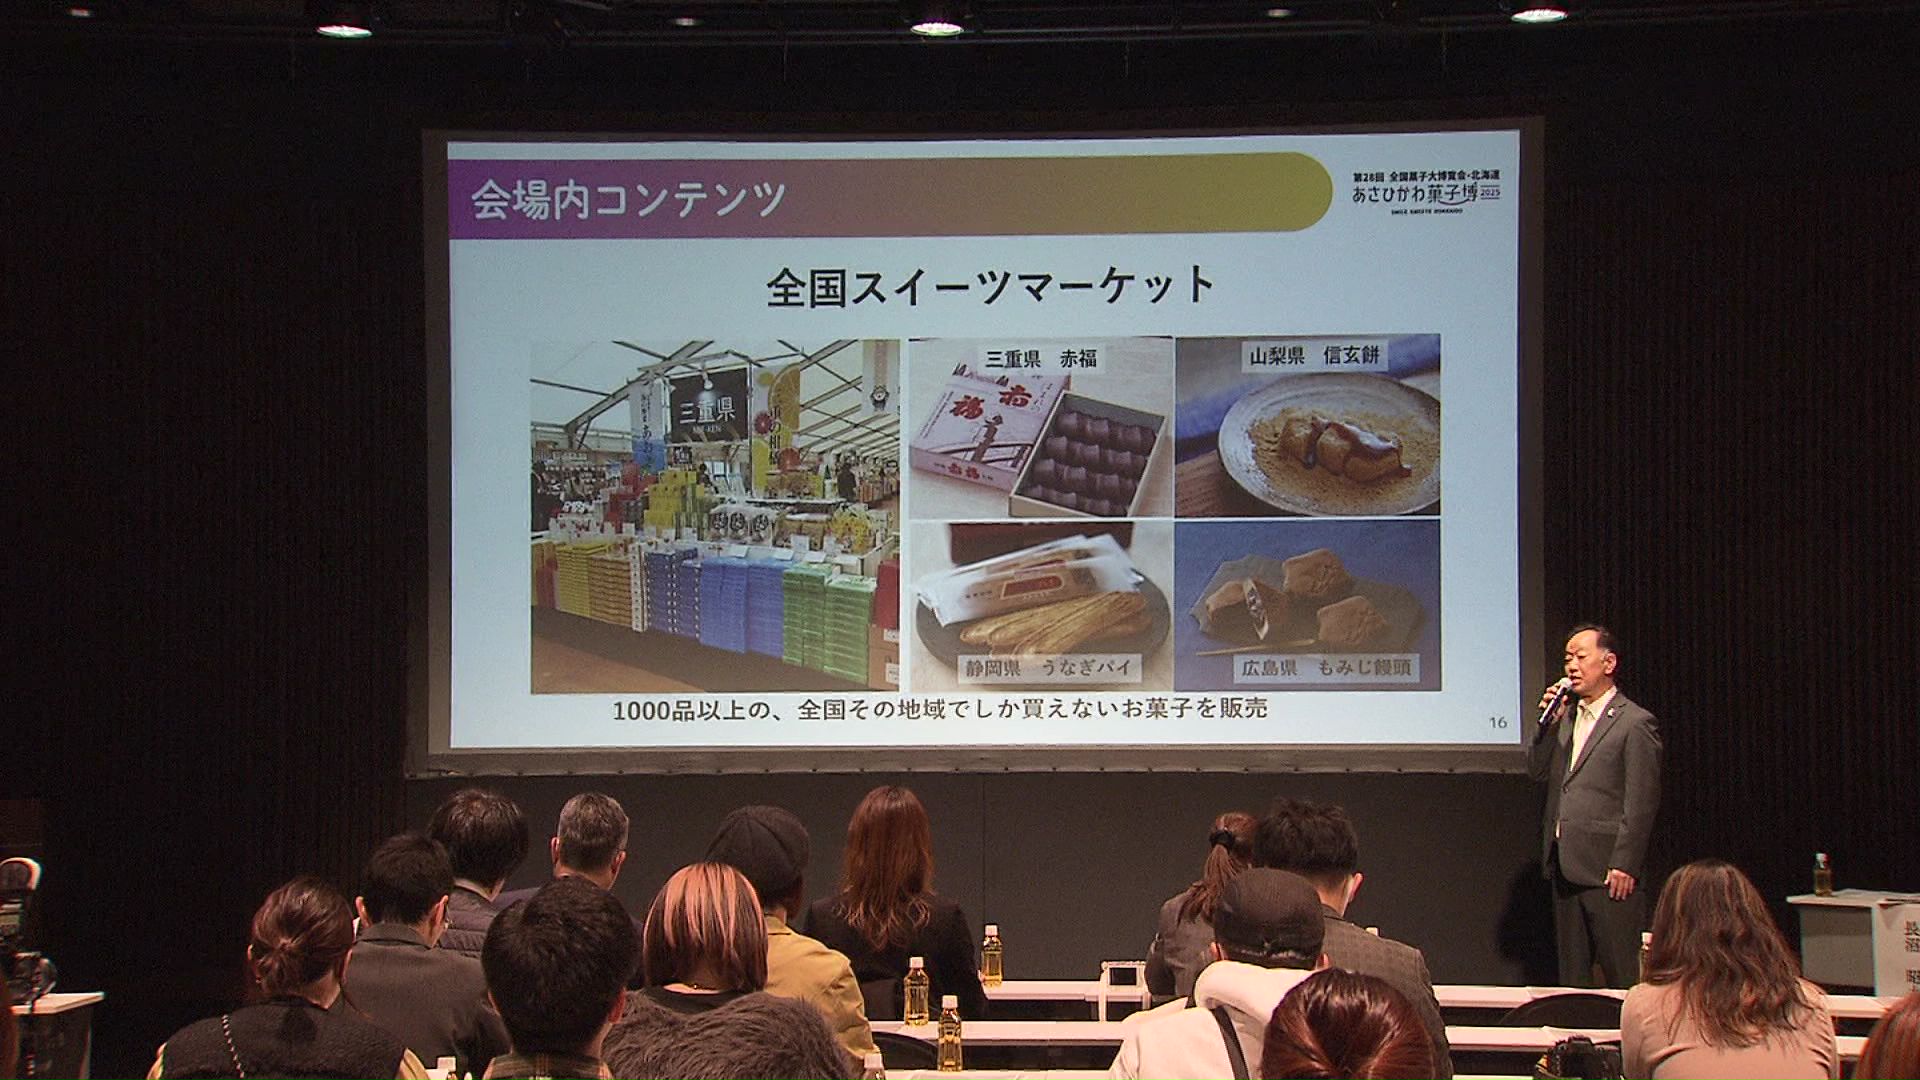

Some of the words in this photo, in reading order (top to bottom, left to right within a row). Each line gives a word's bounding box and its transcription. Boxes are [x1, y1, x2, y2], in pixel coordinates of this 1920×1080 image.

[471, 178, 785, 221] 会場内コンテンツ
[767, 265, 1213, 308] 全国スイーツマーケット
[985, 349, 1041, 368] 三重県
[1060, 349, 1098, 368] 赤福
[1250, 346, 1305, 365] 山梨県
[1323, 345, 1380, 365] 信玄餅
[679, 396, 736, 424] 三重県
[966, 660, 1021, 677] 静岡県
[1042, 659, 1131, 677] うなぎパイ
[1241, 659, 1298, 677] 広島県
[1318, 658, 1413, 676] もみじ饅頭
[613, 697, 1268, 722] 1000品以上の、全国その地域でしか買えないお菓子を販売
[1488, 716, 1508, 729] 16
